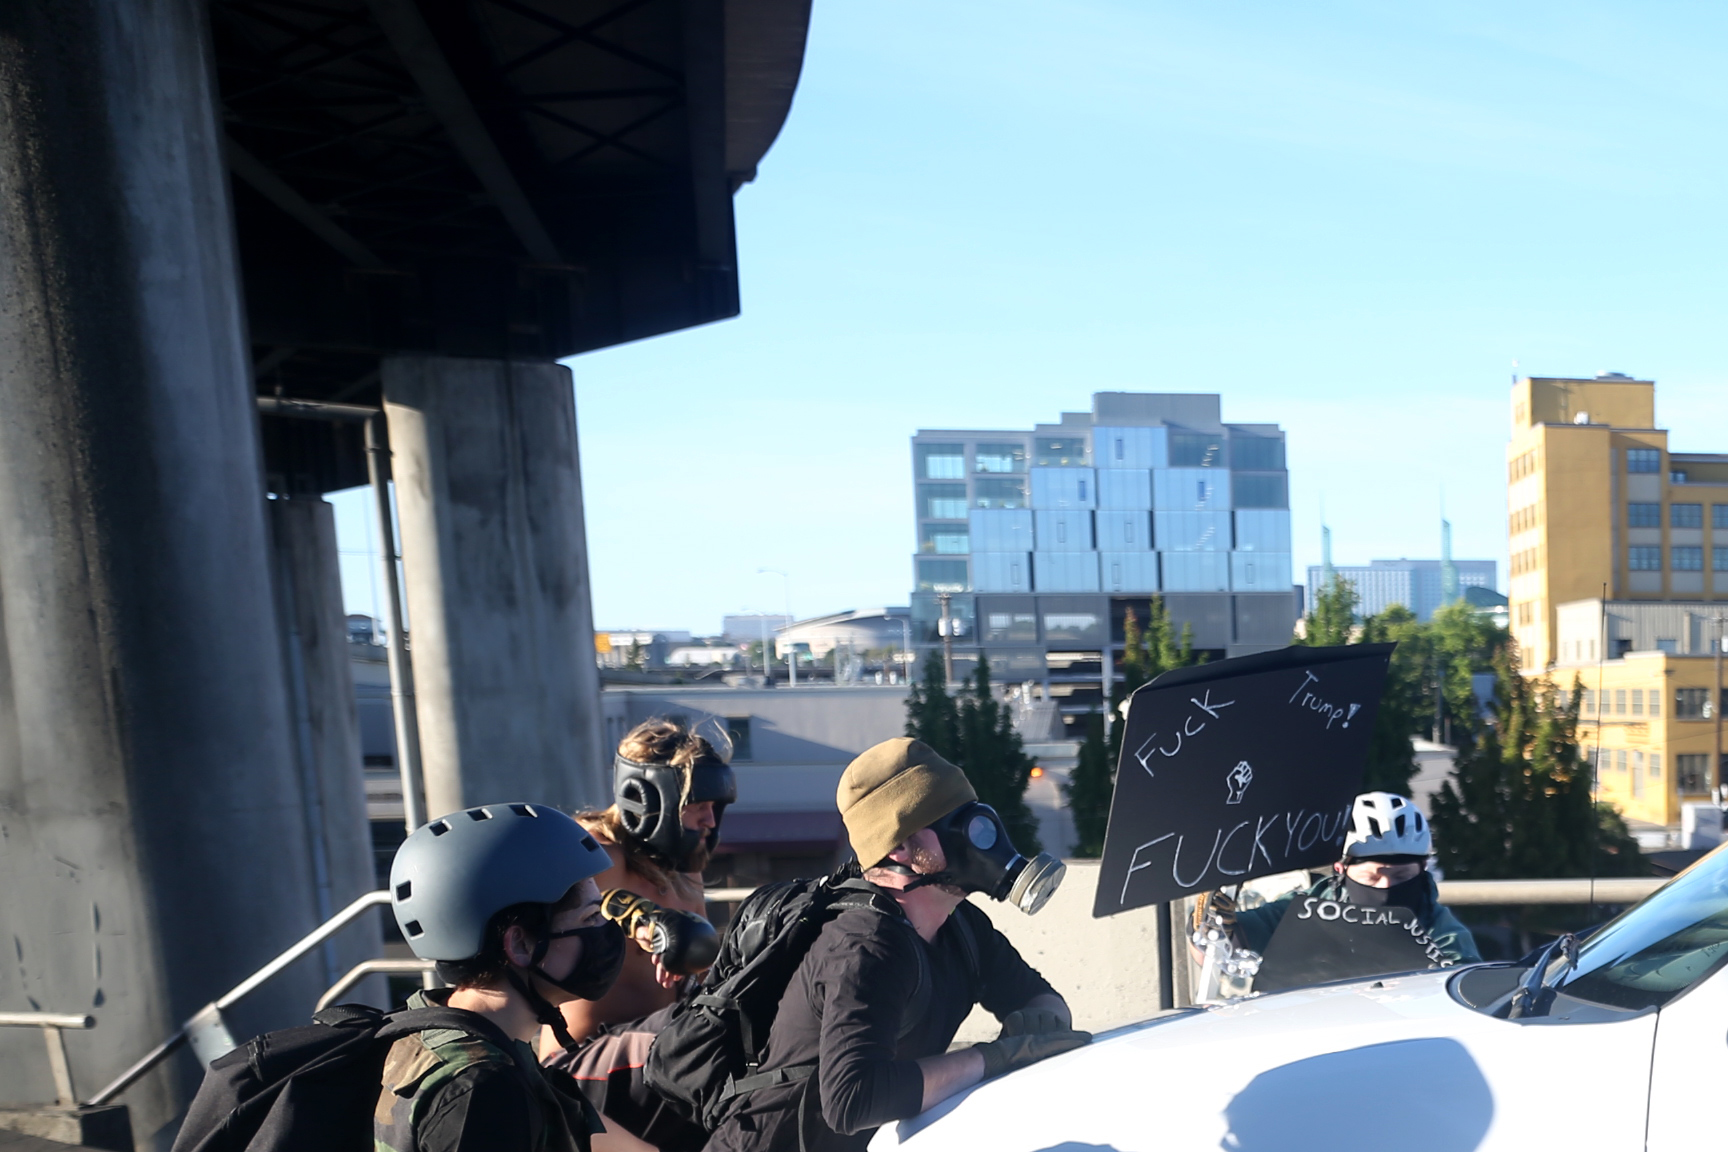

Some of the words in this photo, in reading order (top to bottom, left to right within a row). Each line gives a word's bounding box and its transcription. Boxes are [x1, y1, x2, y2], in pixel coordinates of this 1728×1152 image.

[1135, 689, 1234, 777] FUCK
[1289, 670, 1361, 730] Trump!
[1120, 813, 1280, 904] FUCK
[1297, 897, 1401, 926] SOCIAL
